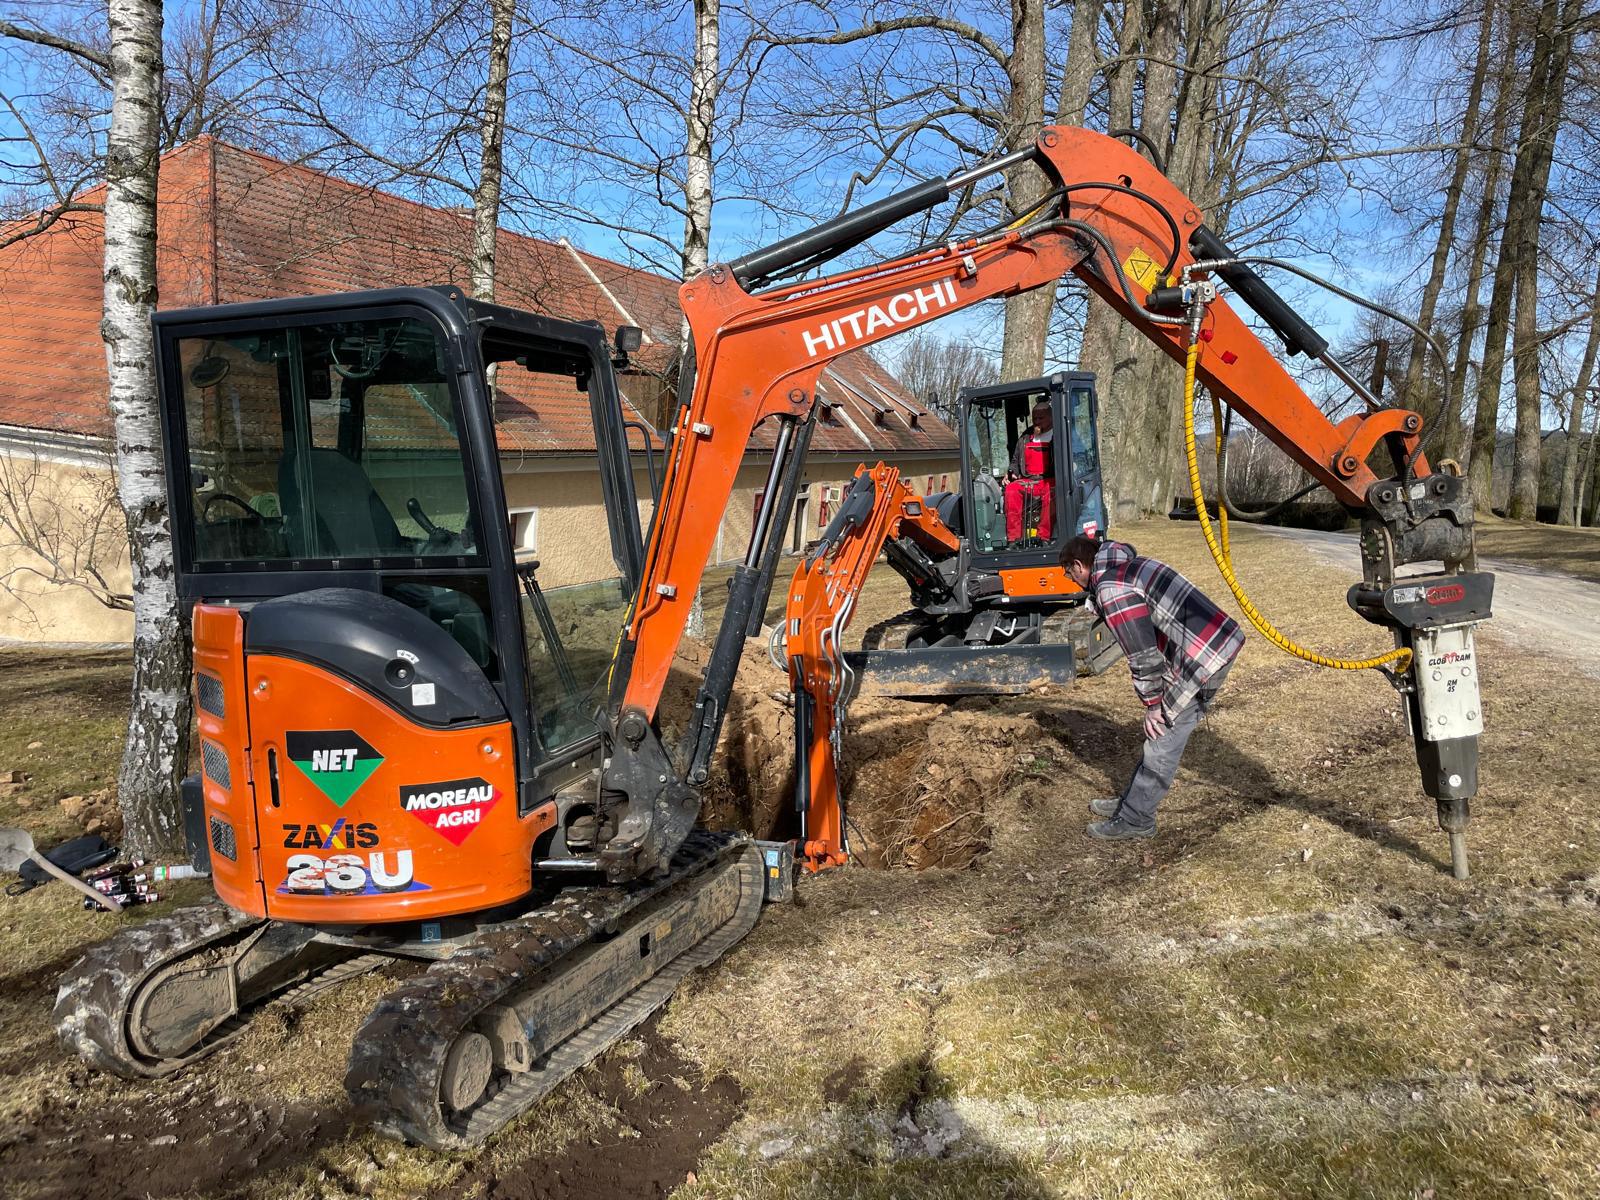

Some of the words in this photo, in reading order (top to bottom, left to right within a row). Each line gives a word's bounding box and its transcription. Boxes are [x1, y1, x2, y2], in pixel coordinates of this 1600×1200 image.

[802, 277, 958, 357] HITACHI
[312, 749, 358, 771] NET
[405, 785, 493, 811] MOREAU
[436, 808, 480, 828] AGRI
[283, 817, 380, 849] ZAXIS
